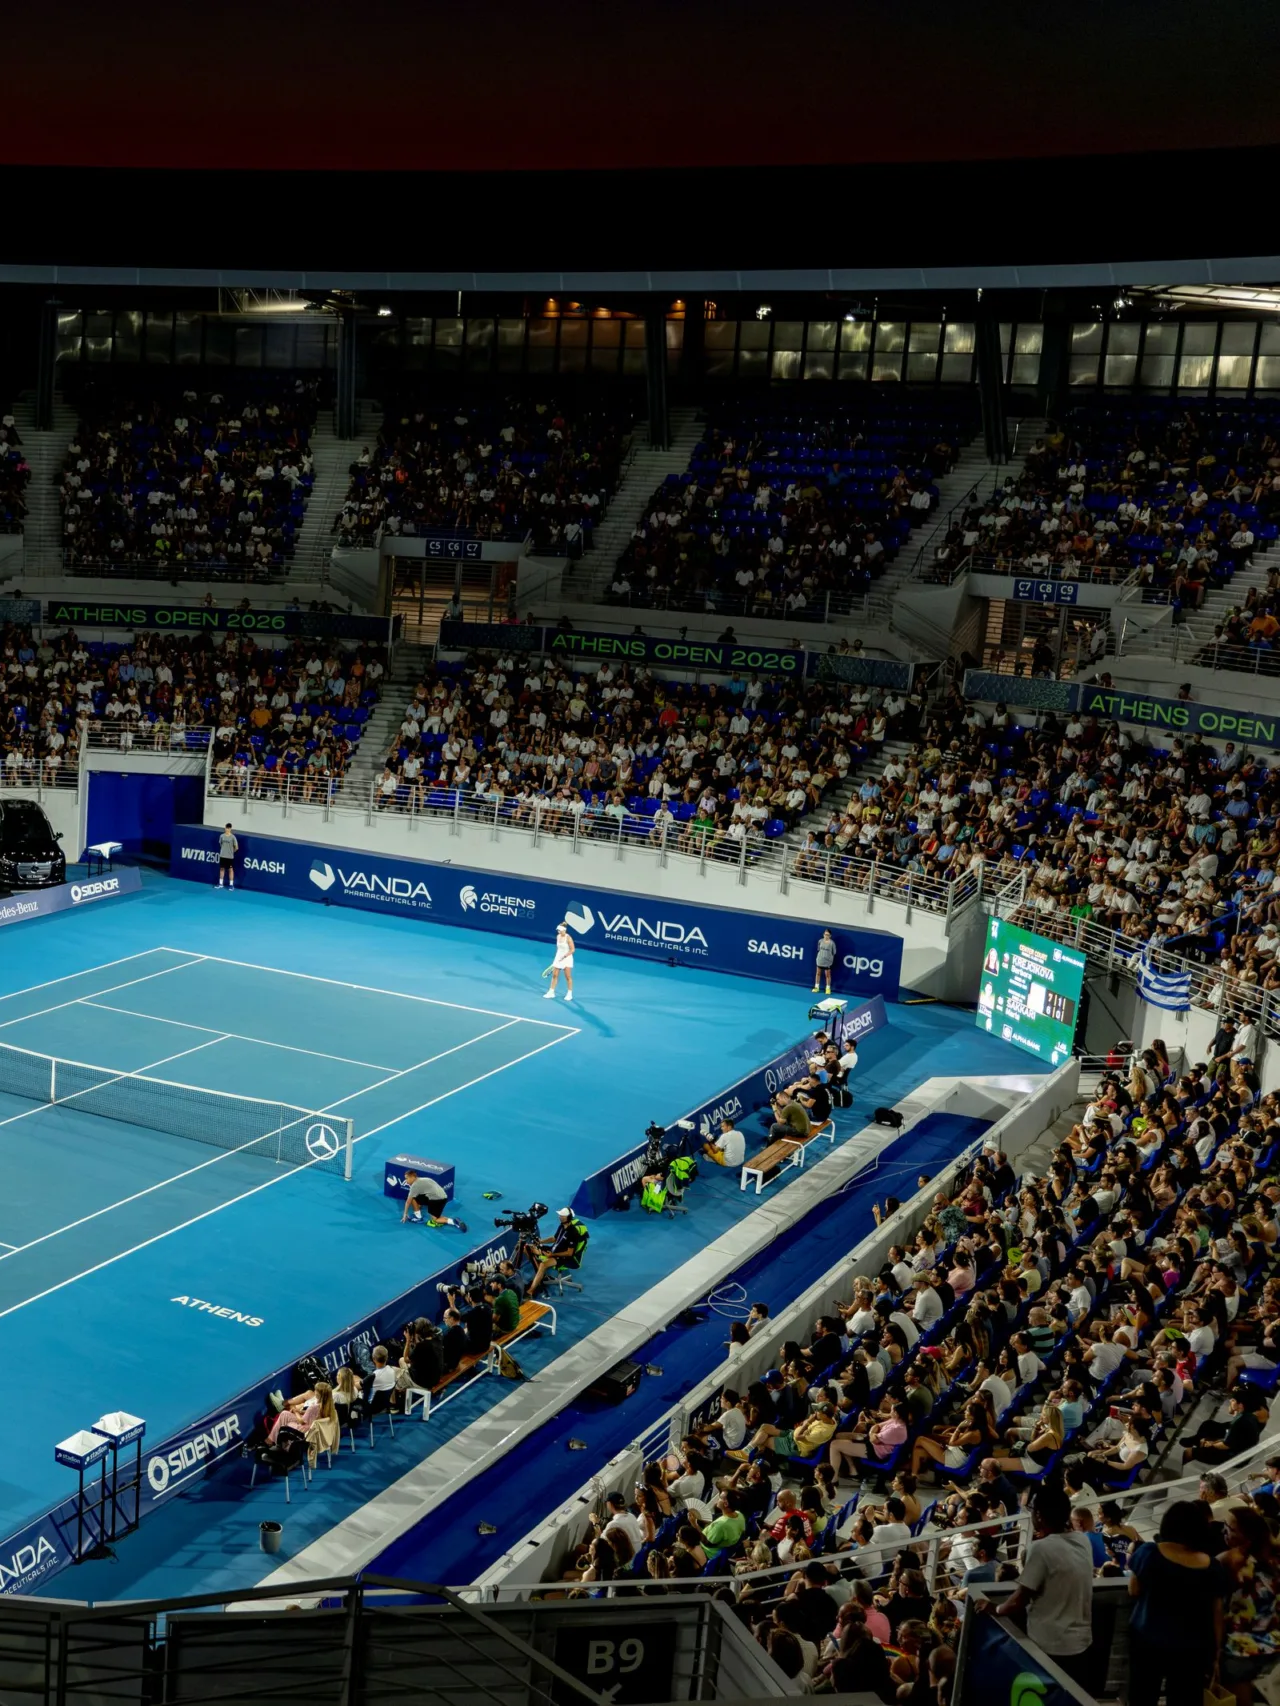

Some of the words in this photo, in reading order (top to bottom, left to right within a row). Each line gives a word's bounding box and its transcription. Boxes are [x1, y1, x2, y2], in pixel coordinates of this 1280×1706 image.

[429, 541, 441, 550] C5
[448, 542, 460, 551] C6
[466, 542, 478, 551] C7
[1018, 580, 1031, 592] C7
[1040, 582, 1052, 594] C8
[1060, 584, 1074, 596] C9
[55, 606, 147, 624] ATHENS
[154, 610, 219, 627] OPEN
[226, 613, 286, 630] 2026
[552, 634, 646, 656] ATHENS
[654, 643, 724, 664] OPEN
[730, 650, 796, 671] 2026
[1089, 694, 1190, 727] ATHENS
[1198, 710, 1276, 741] OPEN
[181, 848, 205, 862] WTA
[206, 852, 220, 864] 250
[244, 857, 285, 874] SAASH
[81, 878, 120, 897] SIDENOR
[337, 868, 432, 902] VANDA
[344, 888, 417, 907] PHARMACEUTICALS
[480, 892, 536, 910] ATHENS
[597, 911, 708, 948] VANDA
[604, 933, 690, 952] PHARMACEUTICALS
[692, 948, 709, 956] INC.
[747, 939, 804, 960] SAASH
[842, 954, 884, 978] apg
[846, 1010, 873, 1036] SIDENOR
[776, 1047, 819, 1084] Mercedes-B
[708, 1096, 742, 1126] VANDA
[170, 1295, 264, 1327] ATHENS
[125, 1426, 144, 1440] stadion
[90, 1444, 108, 1460] stadion
[168, 1414, 242, 1477] SIDENOR
[62, 1453, 81, 1464] stadion
[3, 1565, 46, 1594] ACEUTICALS
[46, 1556, 60, 1569] INC.
[586, 1638, 645, 1674] B9
